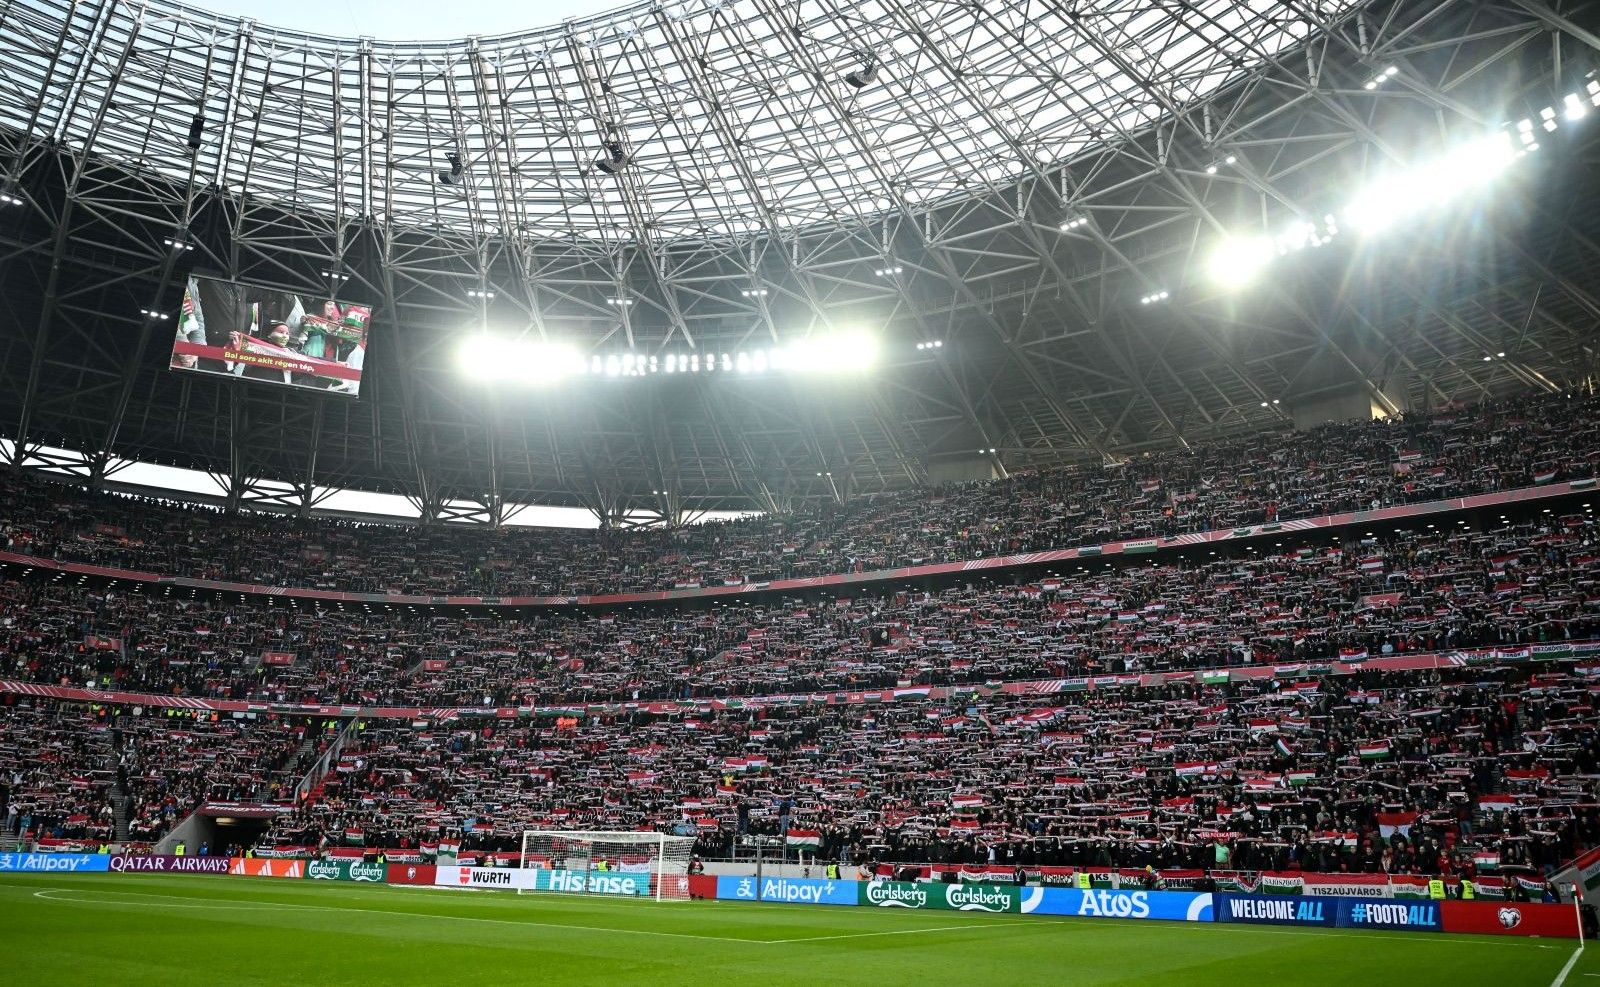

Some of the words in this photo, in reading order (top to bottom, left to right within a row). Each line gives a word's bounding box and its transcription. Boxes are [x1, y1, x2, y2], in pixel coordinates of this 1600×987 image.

[224, 351, 238, 359] Bal
[257, 356, 273, 365] akit
[275, 359, 298, 369] régen
[110, 856, 165, 871] QATAR
[172, 857, 229, 872] AIRWAYS
[308, 860, 341, 878] Carlsberg
[350, 863, 383, 880] Carlsberg
[549, 870, 636, 895] Hisense
[736, 878, 754, 897] 支
[762, 879, 836, 903] Alipay+
[866, 881, 927, 905] Carlsberg
[1312, 886, 1383, 896] TISZAÚJVÁROS
[945, 884, 1011, 910] Carlsberg
[1230, 898, 1296, 920] WELCOME
[1296, 901, 1324, 921] ALL
[1351, 903, 1436, 926] #FOOTBALL
